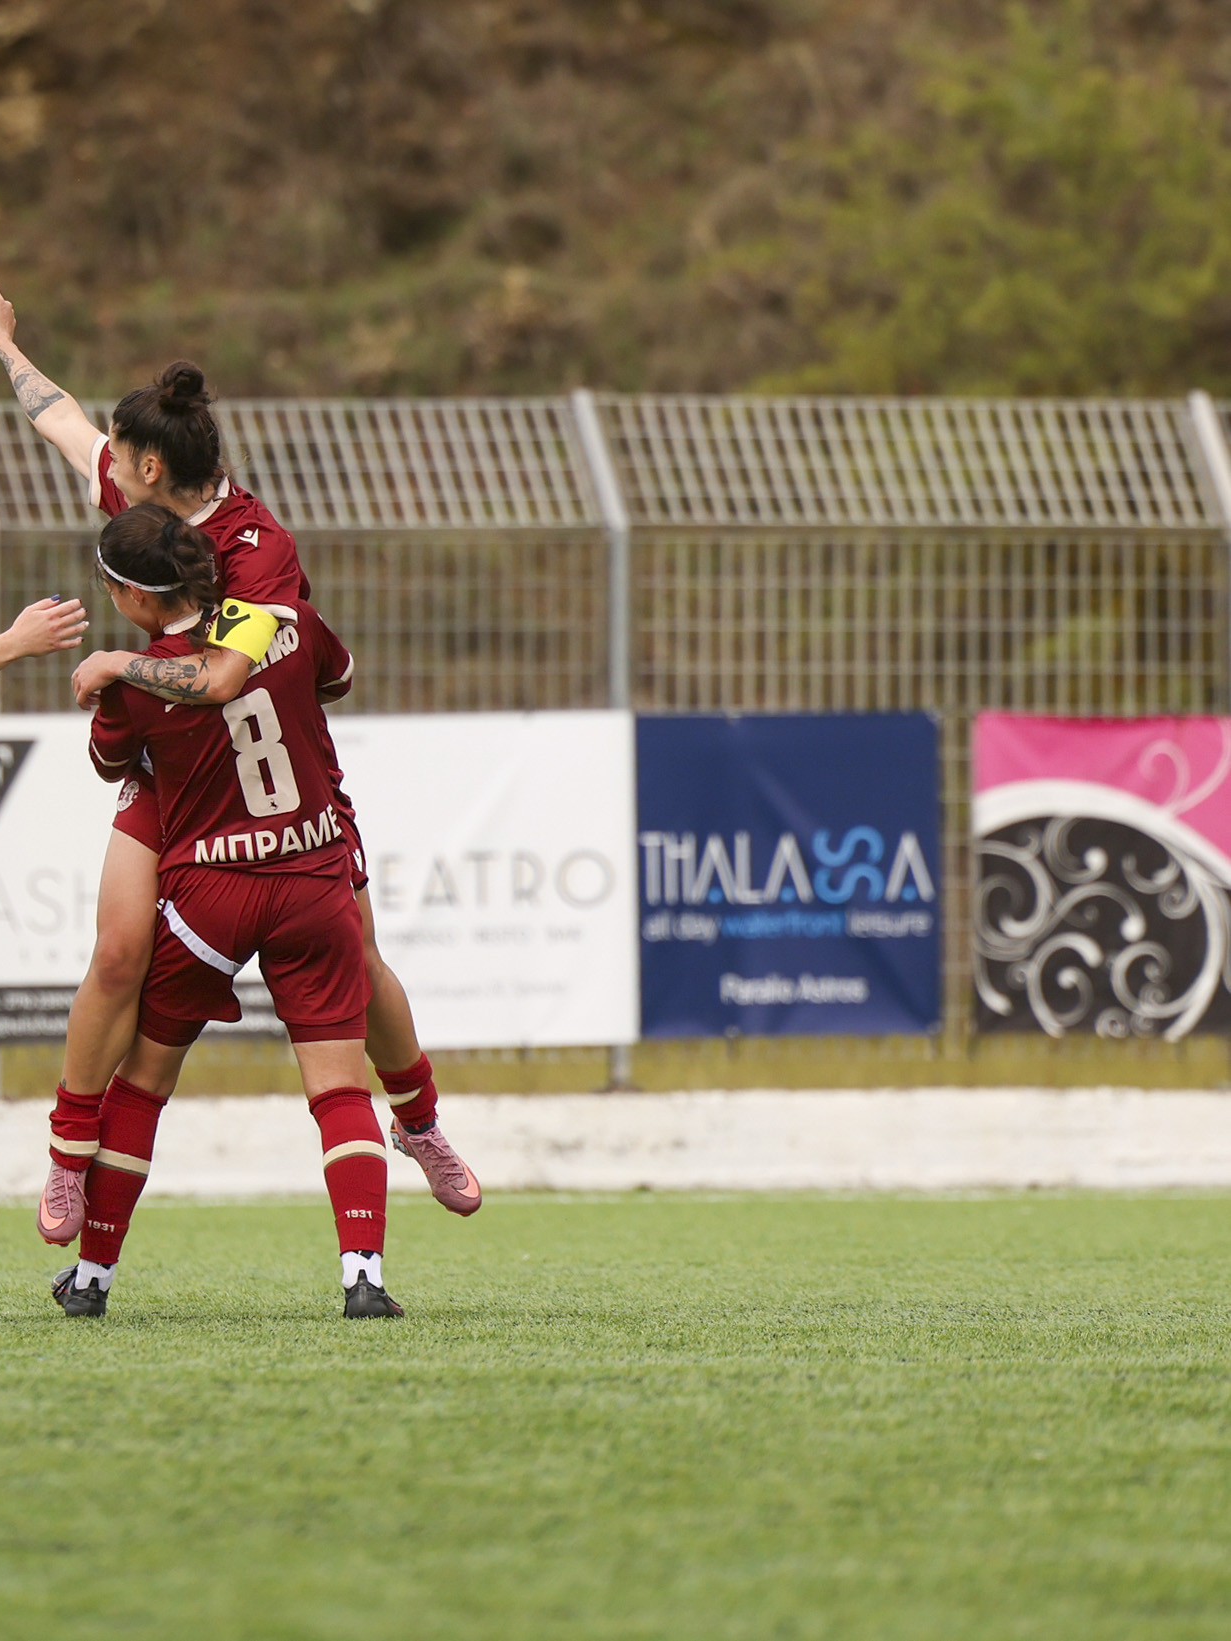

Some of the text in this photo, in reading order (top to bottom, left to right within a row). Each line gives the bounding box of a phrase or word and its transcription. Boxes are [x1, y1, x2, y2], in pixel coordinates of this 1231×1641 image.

[222, 687, 301, 818] 8
[345, 1209, 373, 1219] 1931
[87, 1219, 115, 1233] 1931
